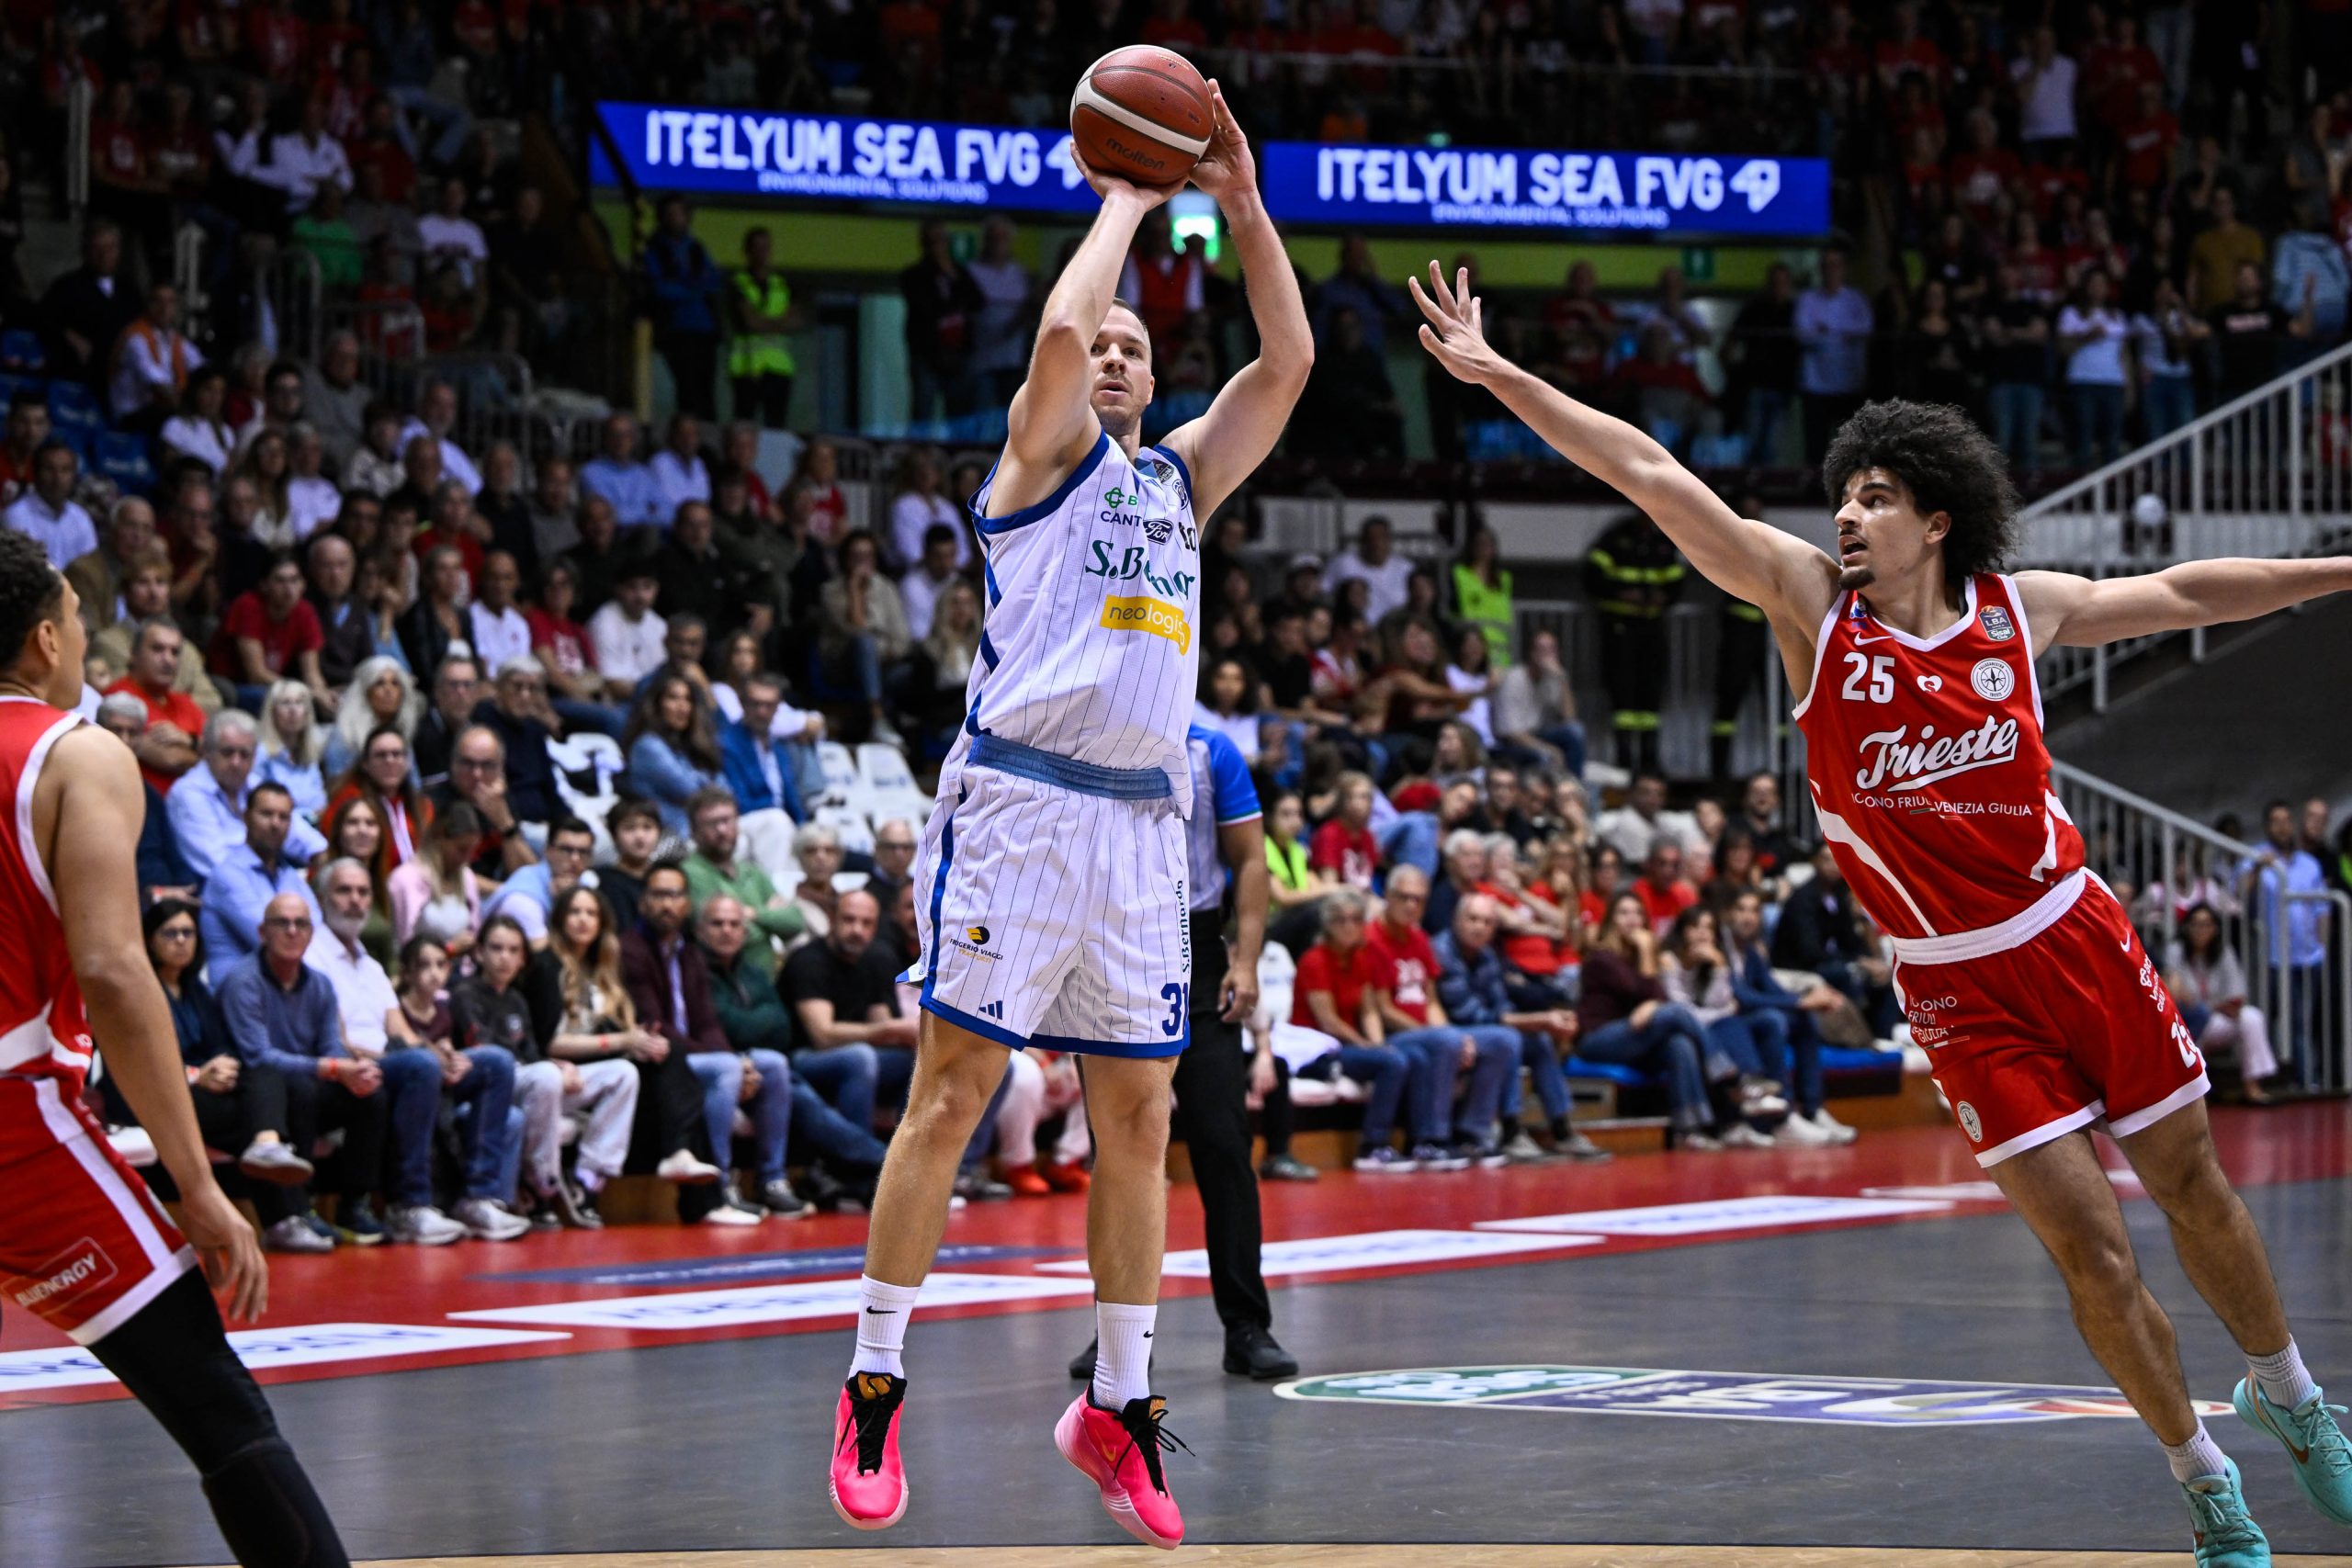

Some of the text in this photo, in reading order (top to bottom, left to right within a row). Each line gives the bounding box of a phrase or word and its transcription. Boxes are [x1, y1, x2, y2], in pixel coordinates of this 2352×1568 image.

[647, 109, 1040, 187] ITELYUM SEA FVG
[1106, 138, 1166, 171] molten
[1317, 148, 1724, 211] ITELYUM SEA FVG
[1101, 511, 1142, 527] CANT
[1984, 616, 2007, 626] LBA
[1990, 628, 2010, 637] Sisal
[1841, 651, 1895, 705] 25
[1856, 715, 2018, 792] Trieste
[1934, 801, 1984, 815] VENEZIA
[1988, 803, 2032, 817] GIULIA
[1175, 880, 1190, 974] S.Bernardo
[949, 938, 1003, 961] FRIGERIO VIAGGI
[1160, 982, 1189, 1036] 31
